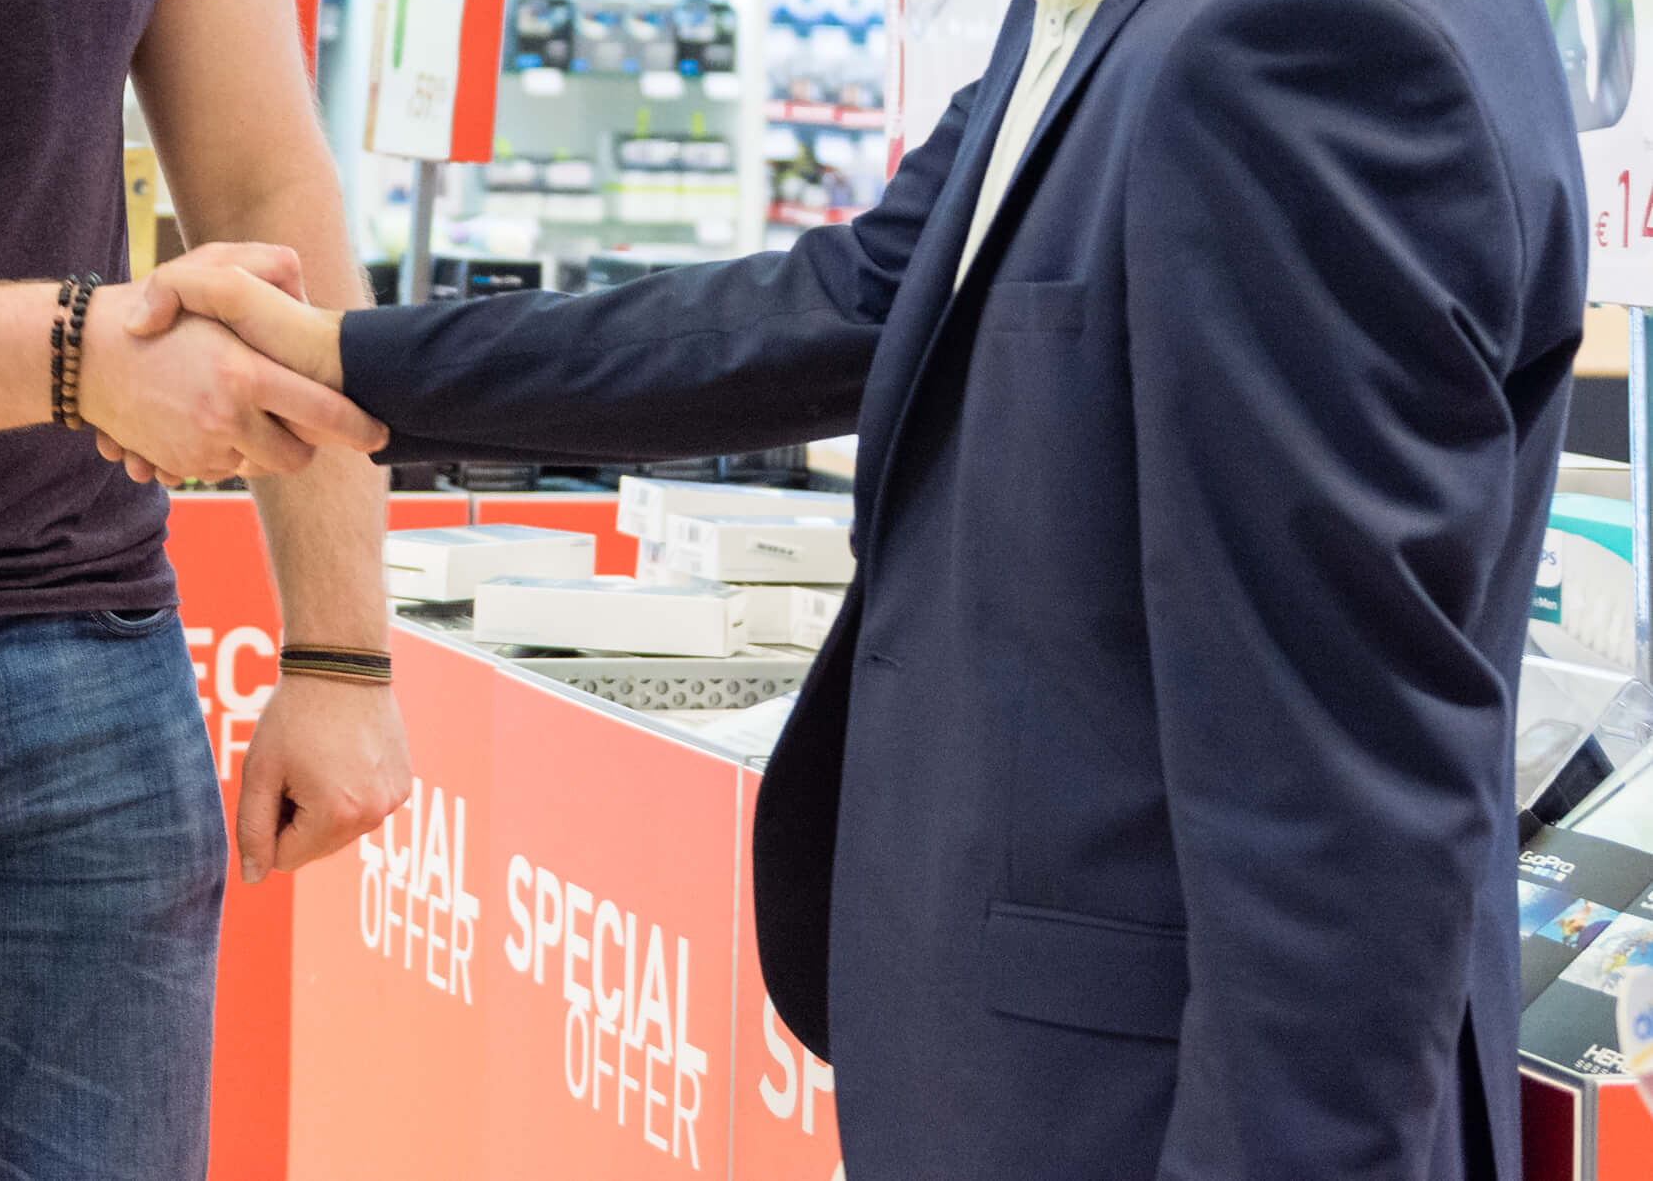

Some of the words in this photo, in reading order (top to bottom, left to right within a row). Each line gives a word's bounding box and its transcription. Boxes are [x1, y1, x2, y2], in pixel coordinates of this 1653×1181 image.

[360, 861, 473, 1006] OFFER
[1518, 850, 1576, 874] GoPro
[504, 853, 709, 1076] SPECIAL
[564, 1000, 701, 1171] OFFER
